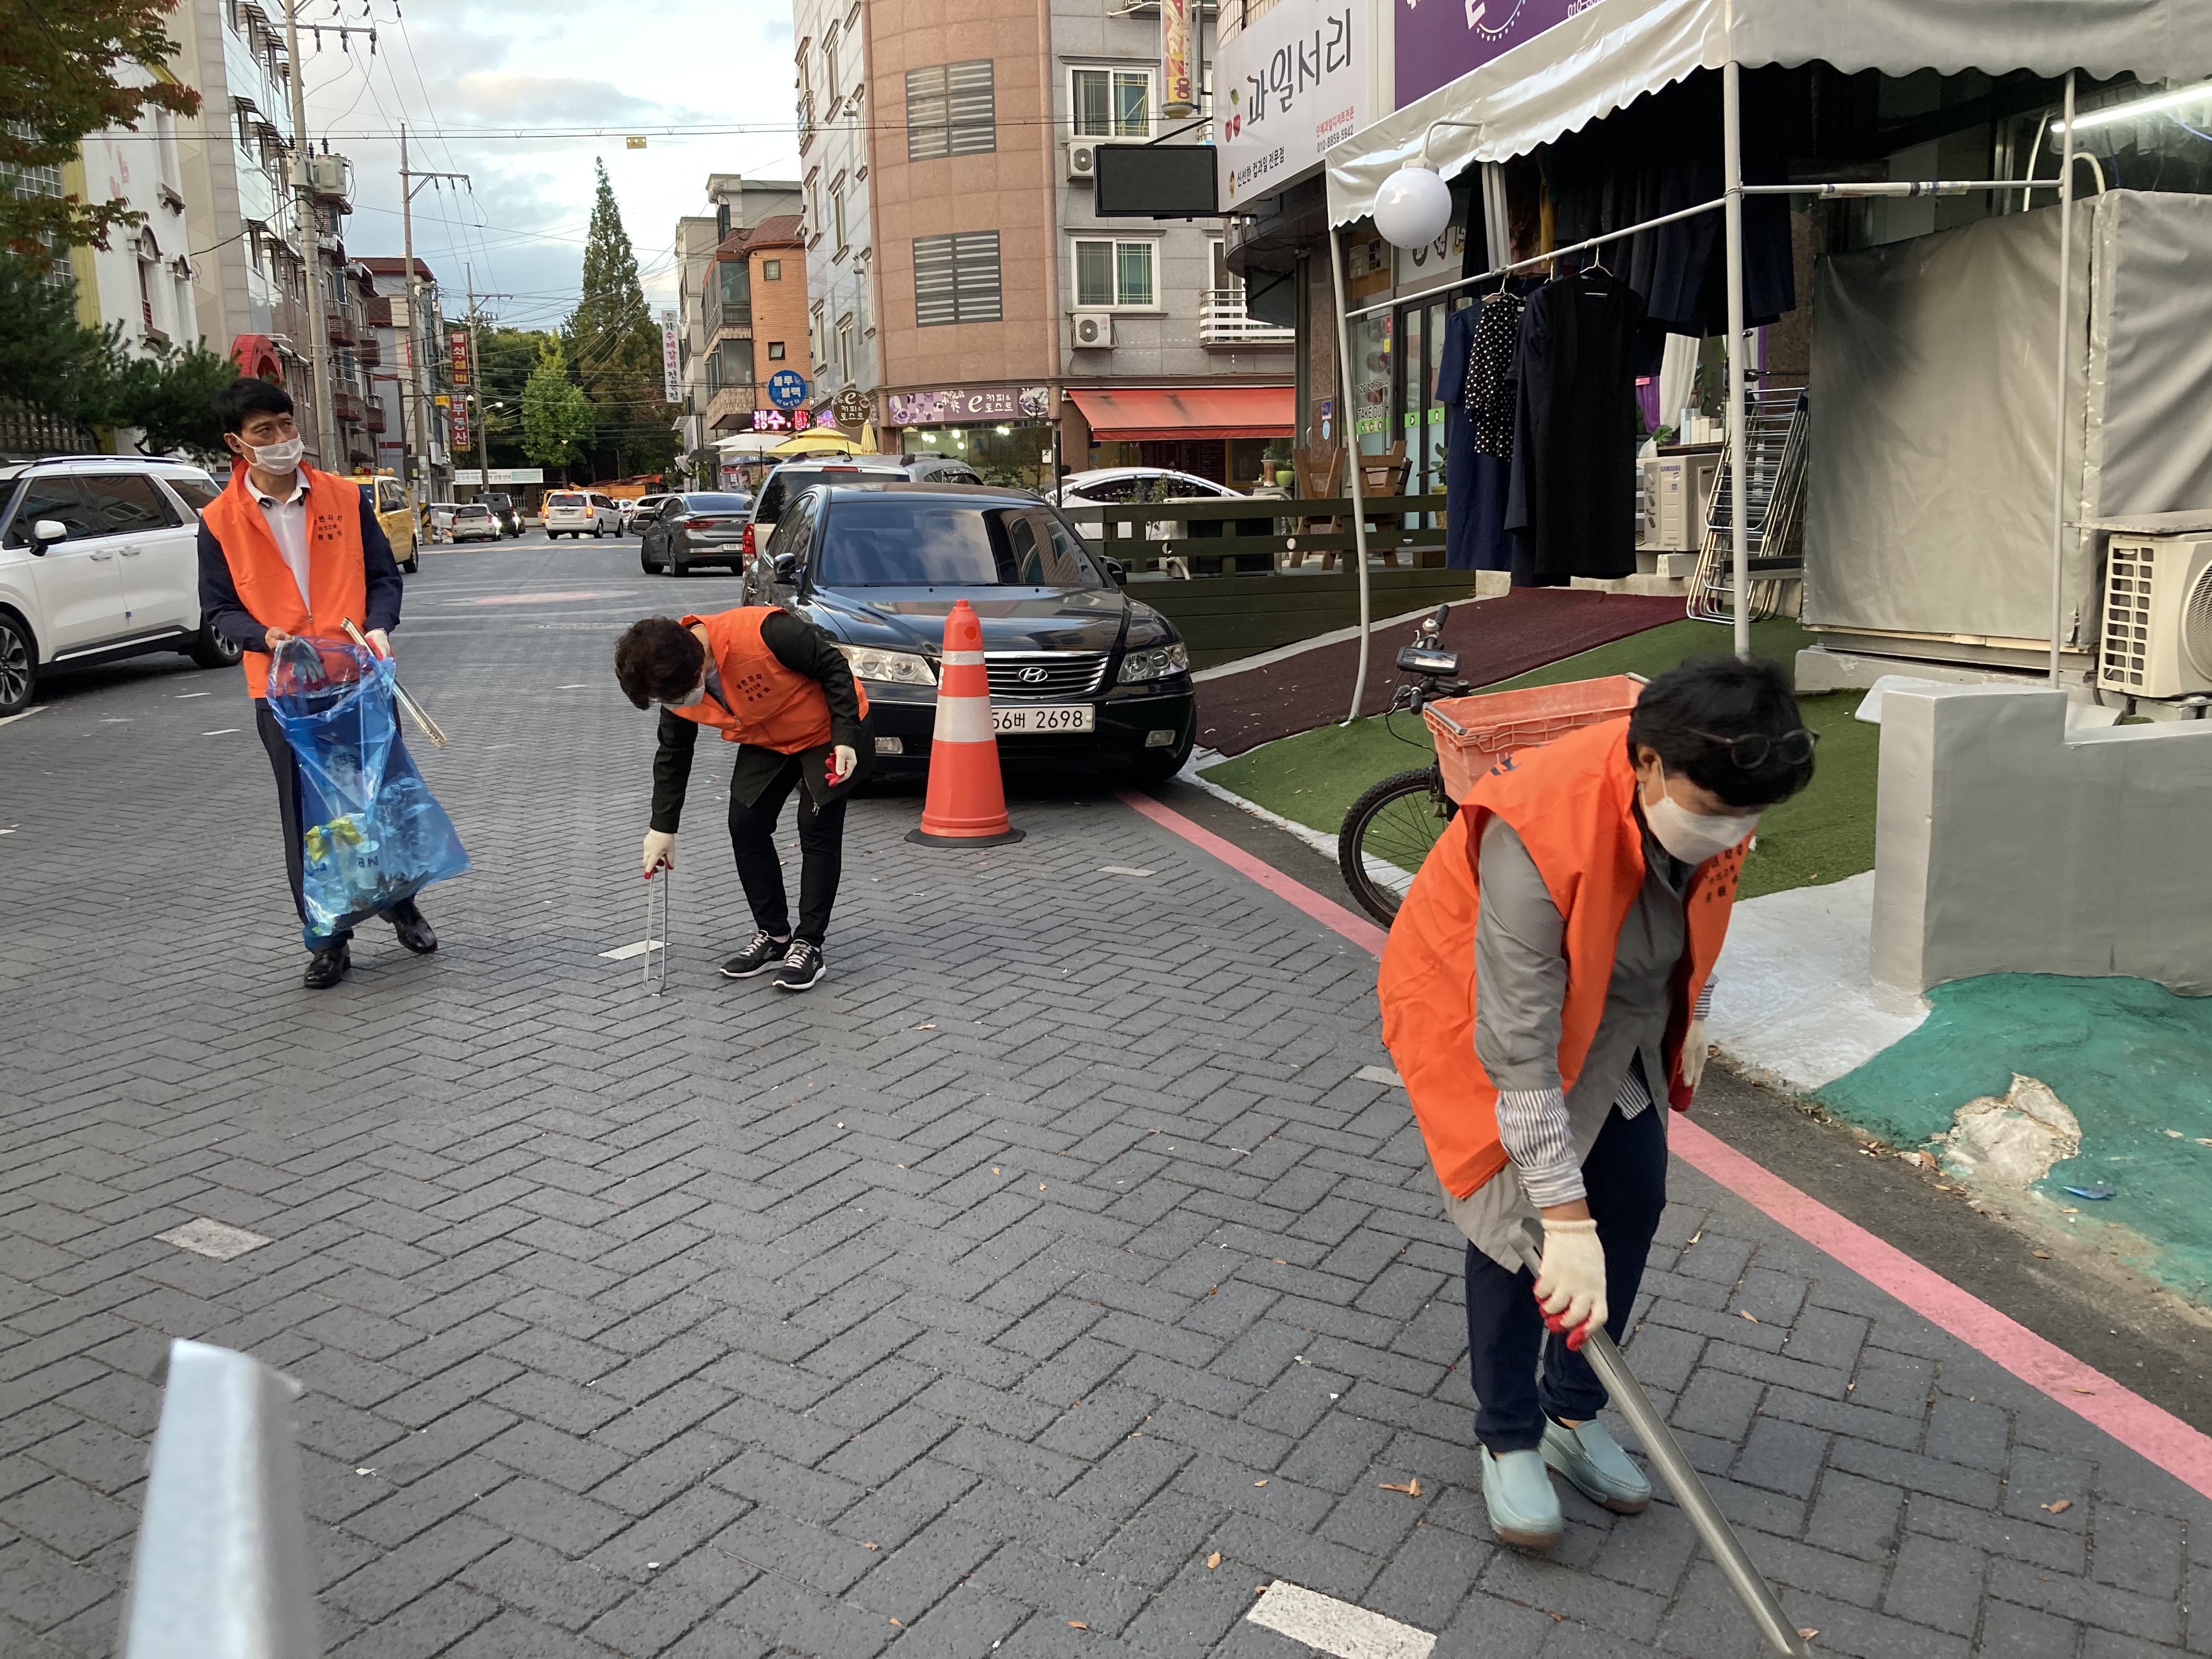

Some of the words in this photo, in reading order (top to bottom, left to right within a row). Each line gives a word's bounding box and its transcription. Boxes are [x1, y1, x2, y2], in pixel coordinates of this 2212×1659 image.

[1247, 8, 1351, 126] 과일서리
[1237, 165, 1251, 187] 신선한
[1269, 145, 1284, 170] 전문점
[840, 413, 865, 421] 토스트
[984, 402, 1014, 413] 토스트
[1358, 406, 1372, 422] TAKE
[452, 403, 467, 445] 부동산
[992, 712, 1025, 730] 56버
[1036, 710, 1083, 729] 2698
